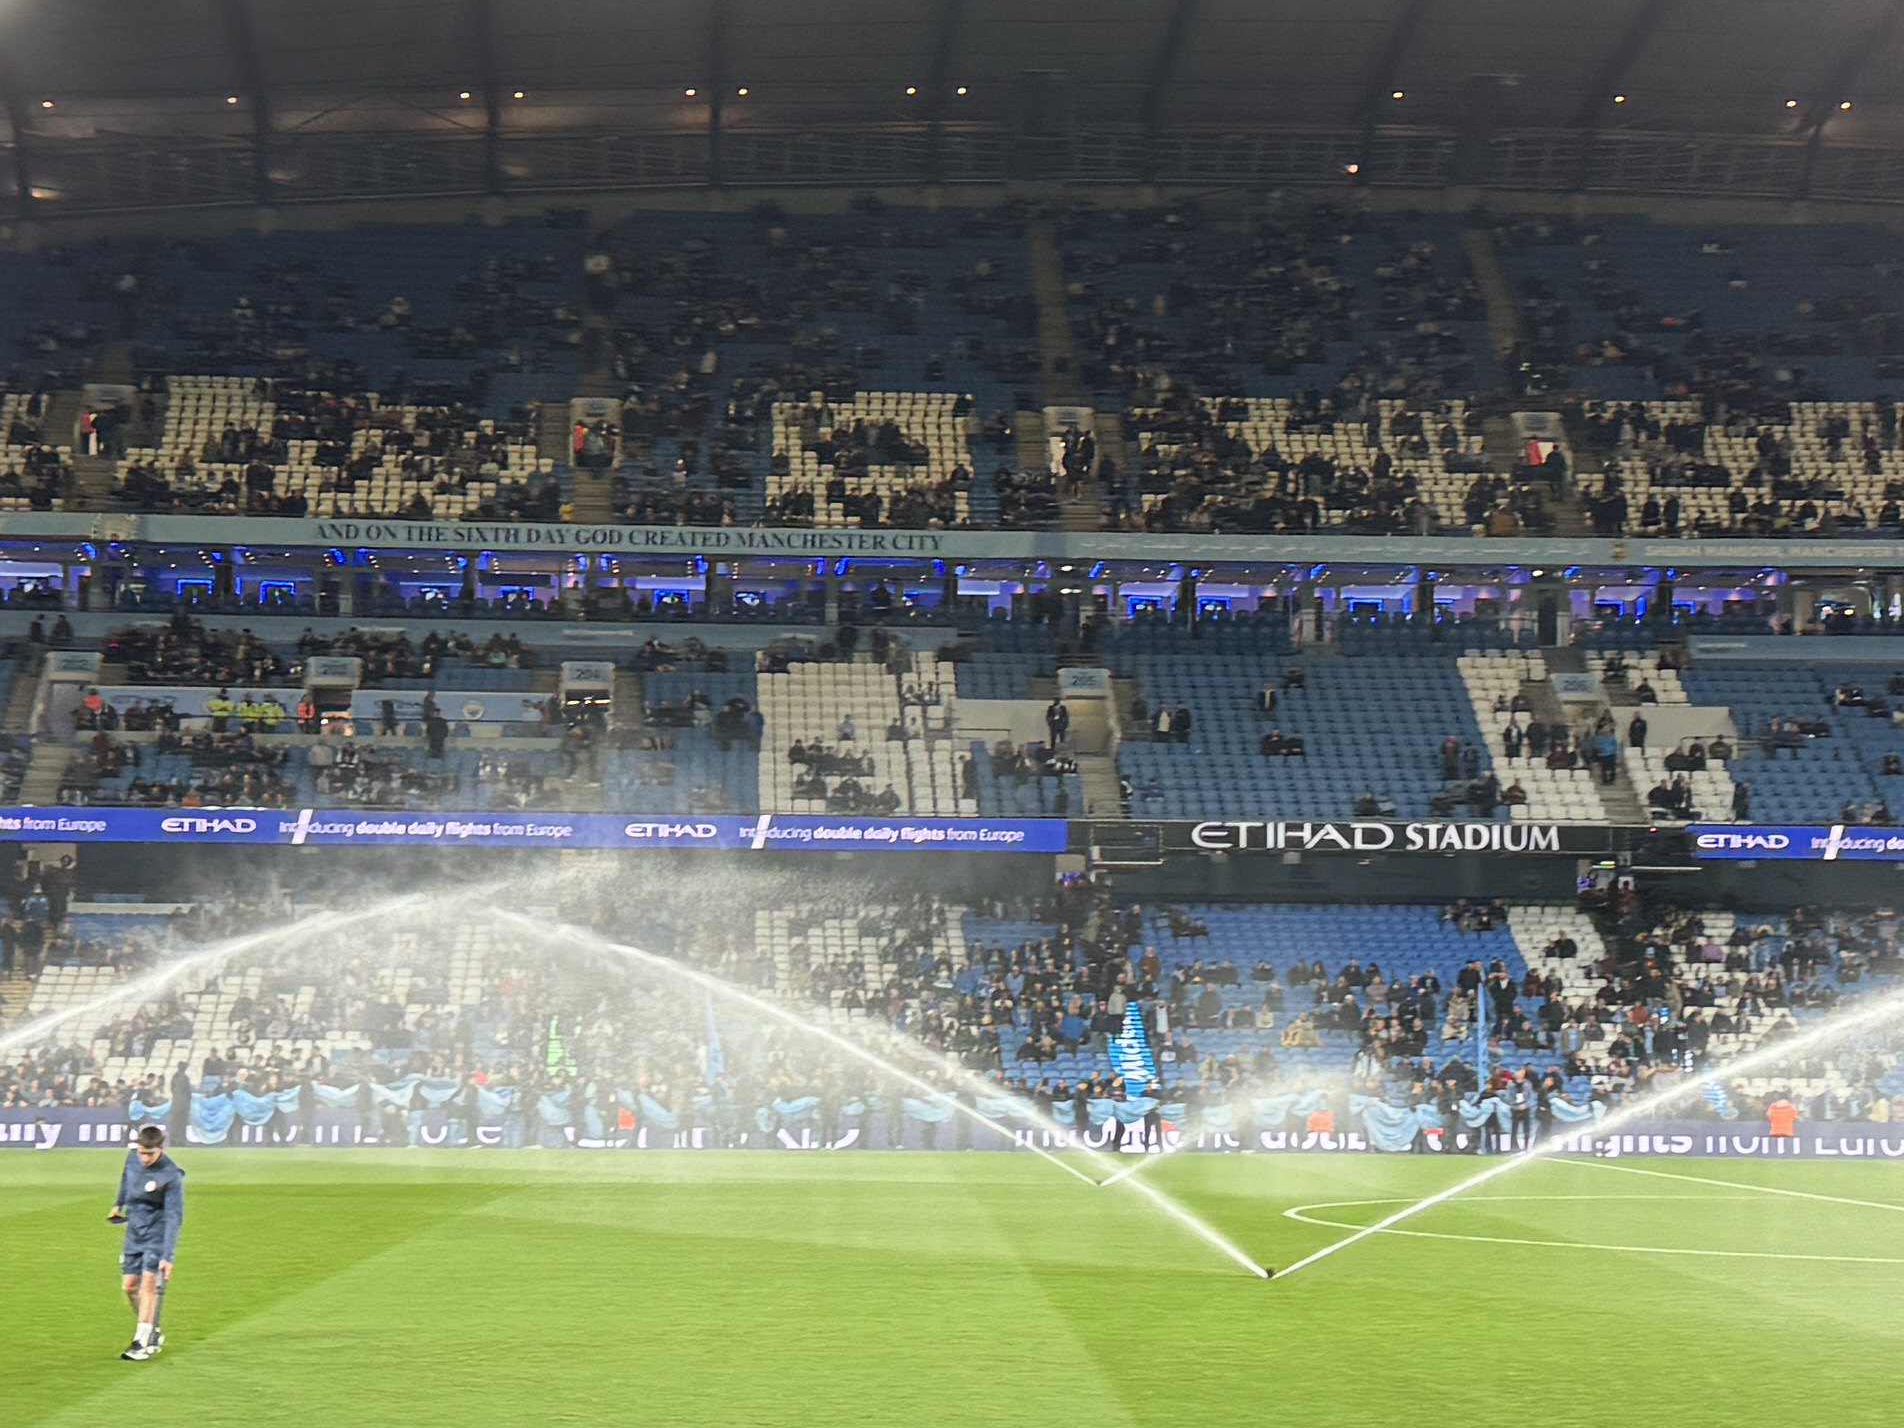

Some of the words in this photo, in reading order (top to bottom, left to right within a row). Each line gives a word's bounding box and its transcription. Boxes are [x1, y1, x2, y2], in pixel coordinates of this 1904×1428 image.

[313, 523, 357, 540] AND
[365, 524, 396, 541] ON
[406, 525, 446, 542] THE
[453, 525, 517, 543] SIXTH
[525, 527, 569, 545] DAY
[573, 529, 621, 546] GOD
[628, 529, 730, 548] CREATED
[736, 531, 884, 549] MANCHESTER
[890, 534, 943, 551] CITY
[22, 816, 56, 831] from
[57, 817, 107, 833] Europe
[161, 817, 257, 833] ETIHAD
[355, 821, 407, 835] double
[407, 821, 445, 838] daily
[445, 821, 492, 839] flights
[492, 822, 525, 836] from
[525, 823, 573, 839] Europe
[624, 823, 717, 838] ETIHAD
[813, 826, 863, 840] double
[864, 827, 900, 843] daily
[900, 826, 946, 844] flights
[946, 827, 978, 841] from
[978, 828, 1025, 843] Europe
[1191, 821, 1395, 850] ETIHAD
[1405, 822, 1561, 851] STADIUM
[1696, 834, 1790, 849] ETIHAD
